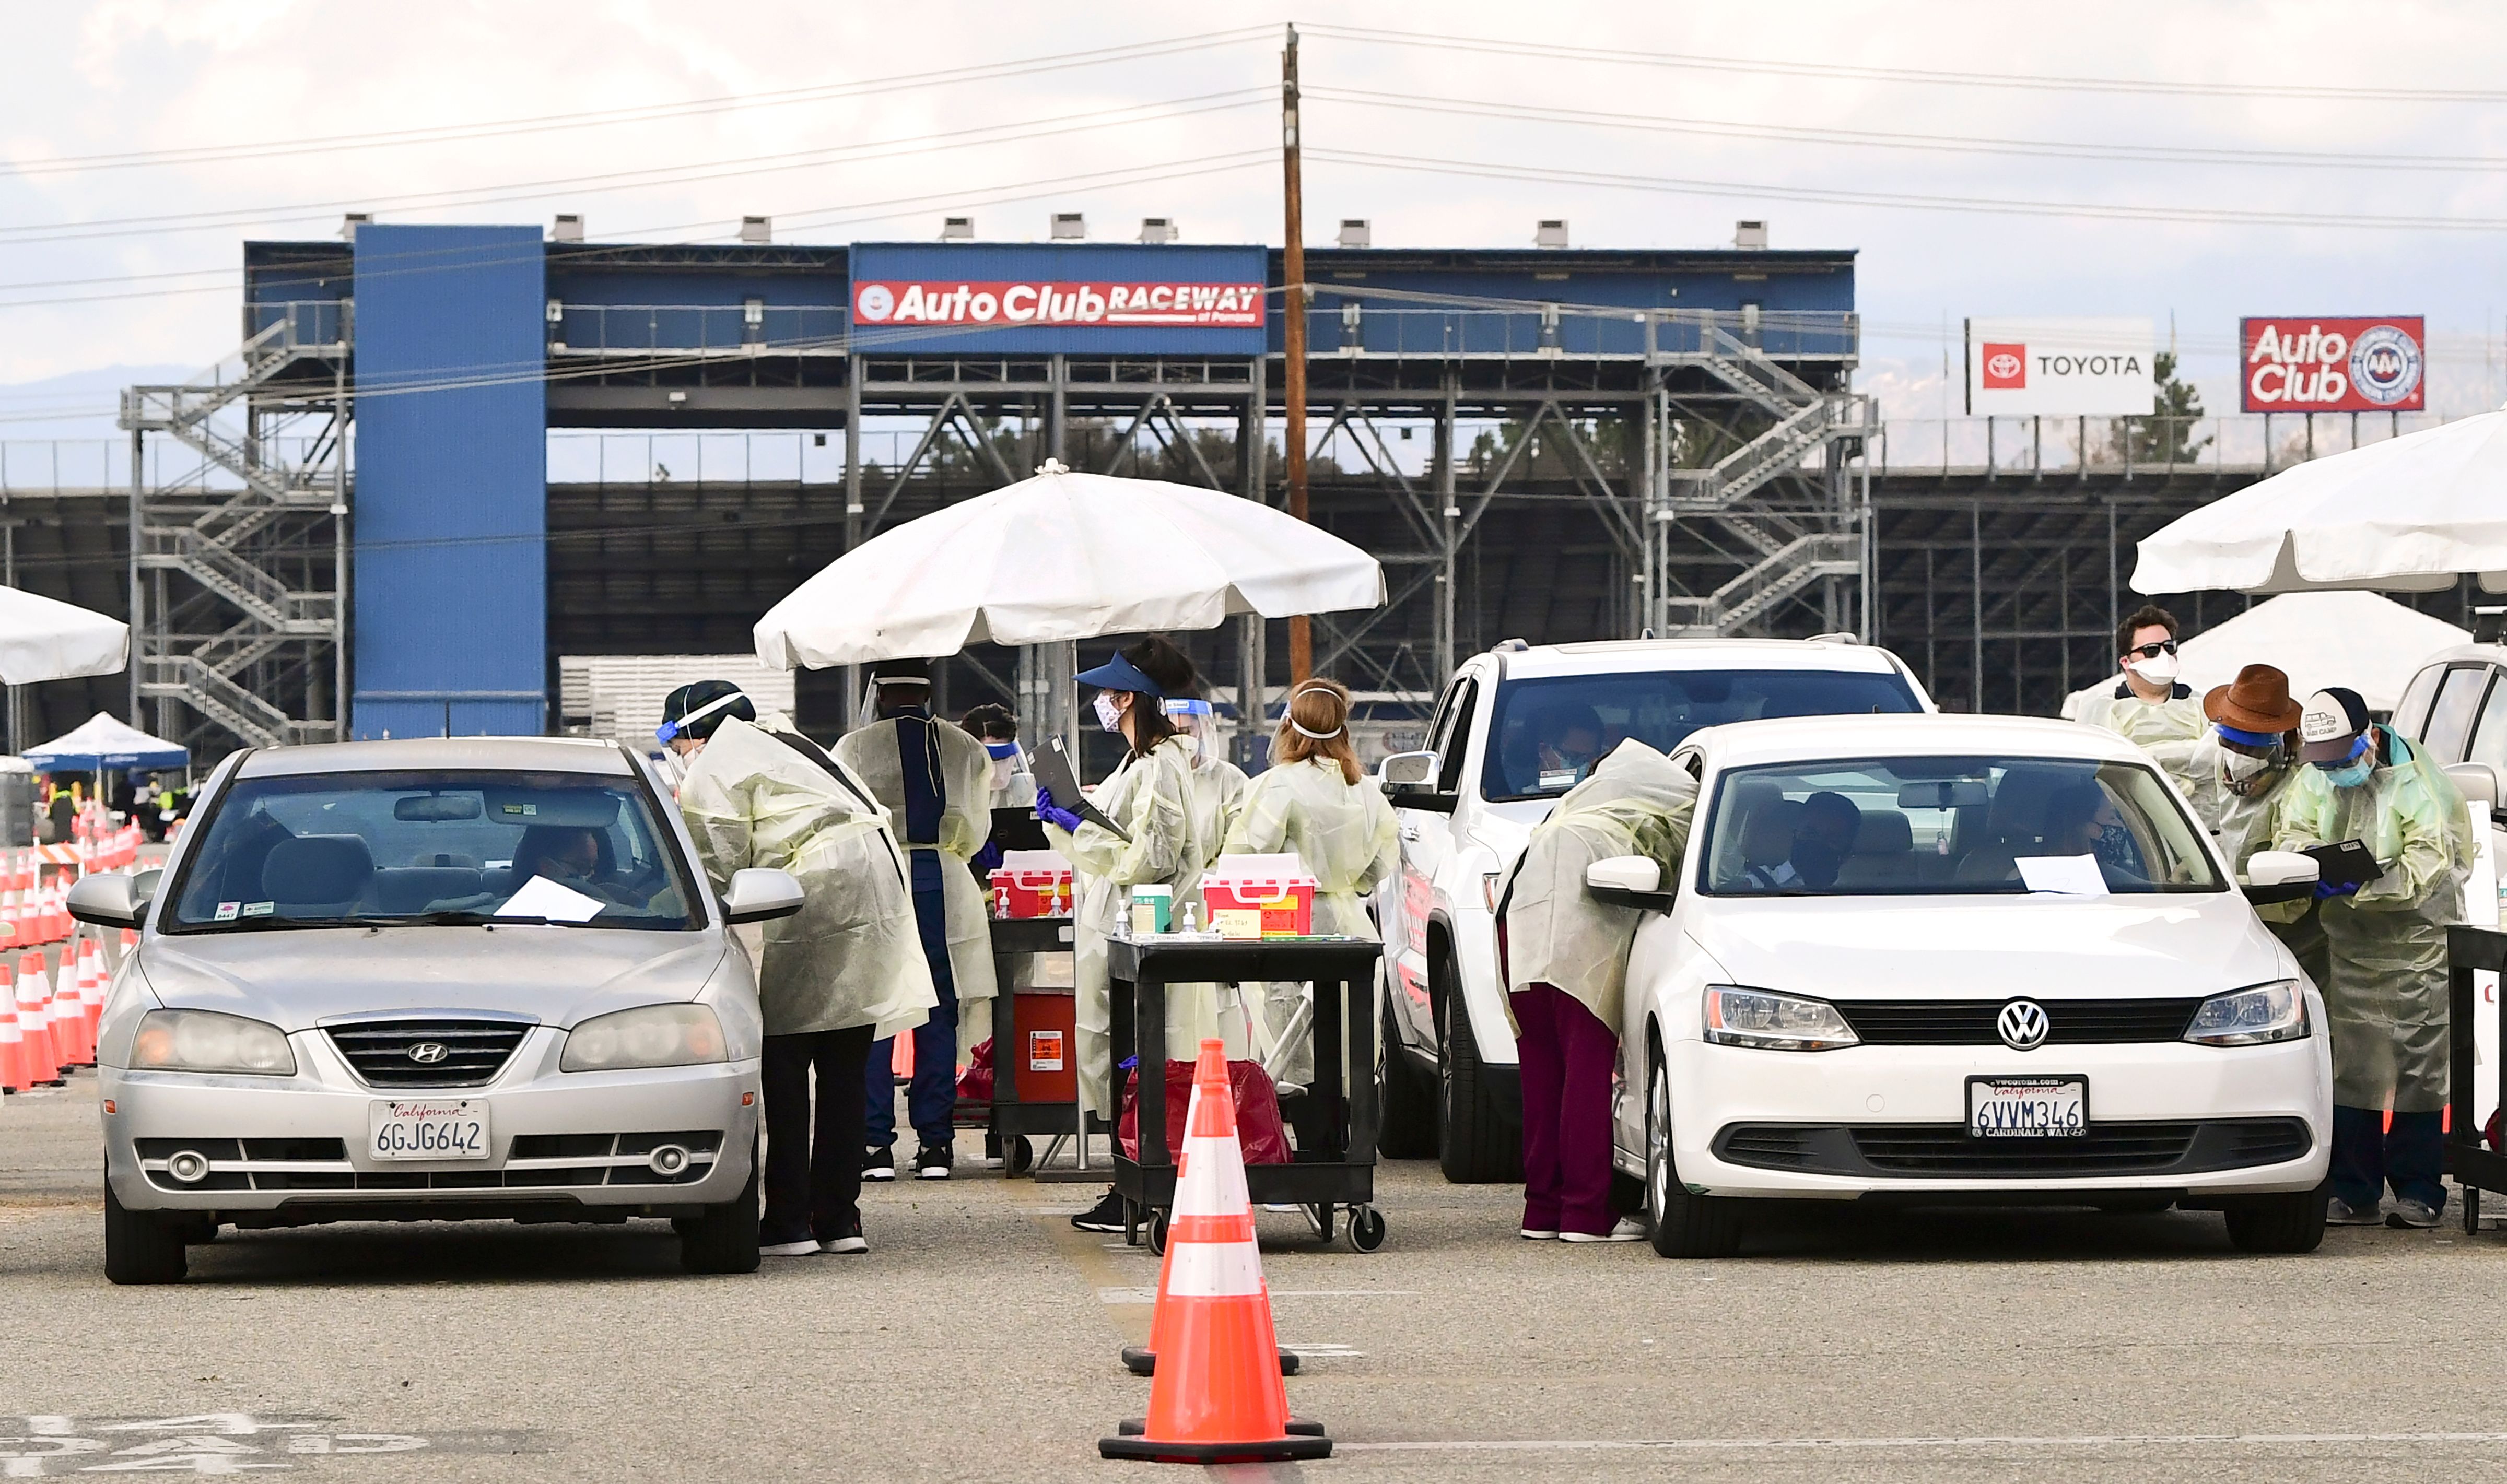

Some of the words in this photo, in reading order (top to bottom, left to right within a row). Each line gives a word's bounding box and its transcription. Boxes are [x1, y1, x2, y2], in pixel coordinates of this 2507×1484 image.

[893, 285, 998, 322] Auto
[1002, 285, 1106, 322] Club
[1108, 286, 1259, 312] RACEWAY
[2248, 324, 2347, 365] Auto
[2037, 355, 2142, 376] TOYOTA
[2251, 363, 2348, 403] Club
[1994, 1087, 2065, 1099] California
[394, 1104, 467, 1121] California
[1978, 1101, 2079, 1128] 6VVM346
[377, 1122, 481, 1151] 6GJG642
[1986, 1128, 2044, 1137] CARDINALE
[2046, 1128, 2068, 1137] WAY
